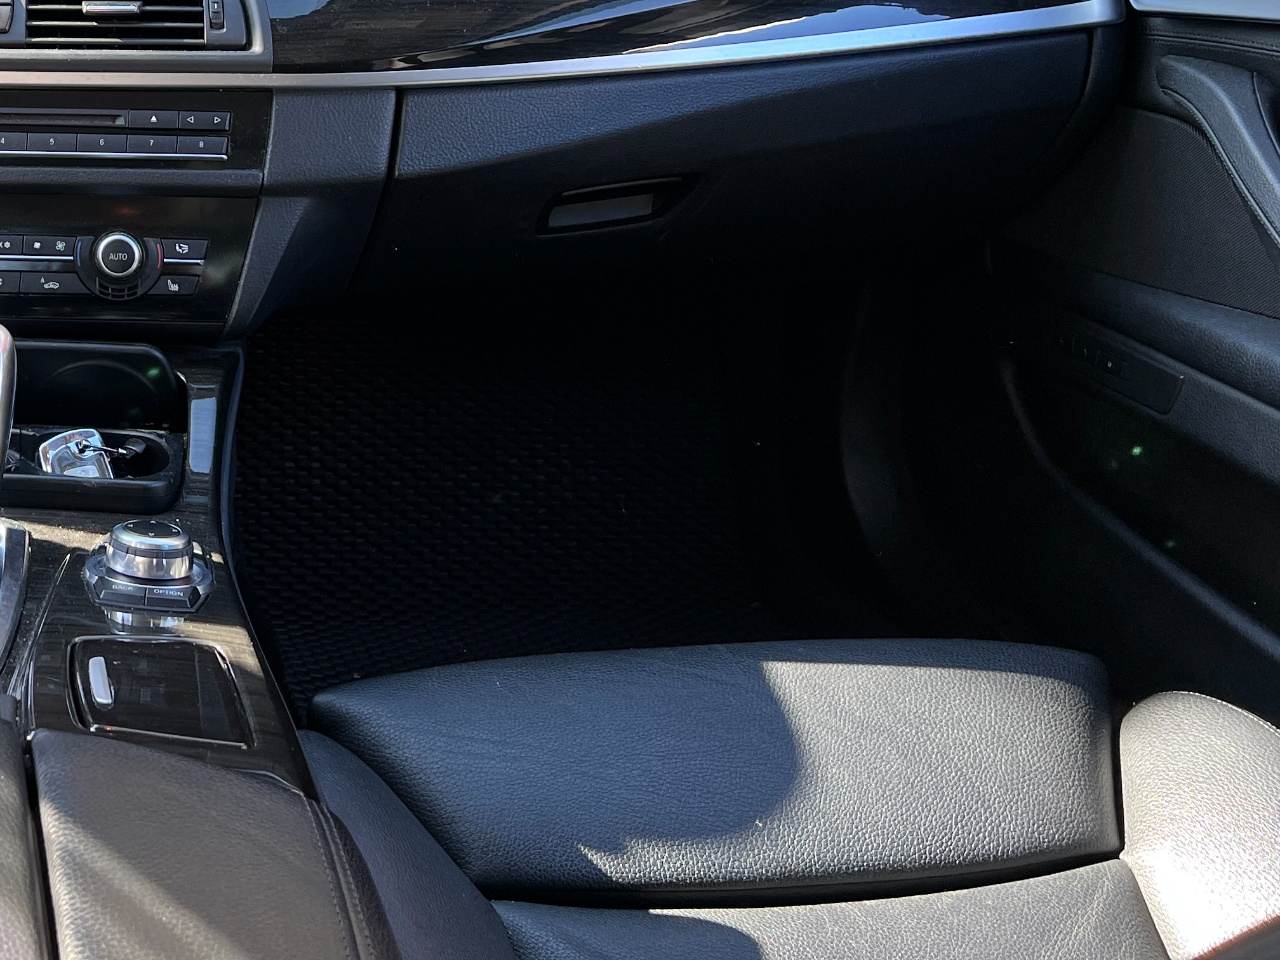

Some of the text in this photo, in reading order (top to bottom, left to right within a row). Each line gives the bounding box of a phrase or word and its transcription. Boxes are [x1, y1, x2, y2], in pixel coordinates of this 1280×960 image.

[99, 138, 105, 146] 6
[149, 139, 154, 147] 7
[199, 140, 204, 148] 8
[108, 253, 128, 261] AUTO
[153, 588, 184, 597] OPTION
